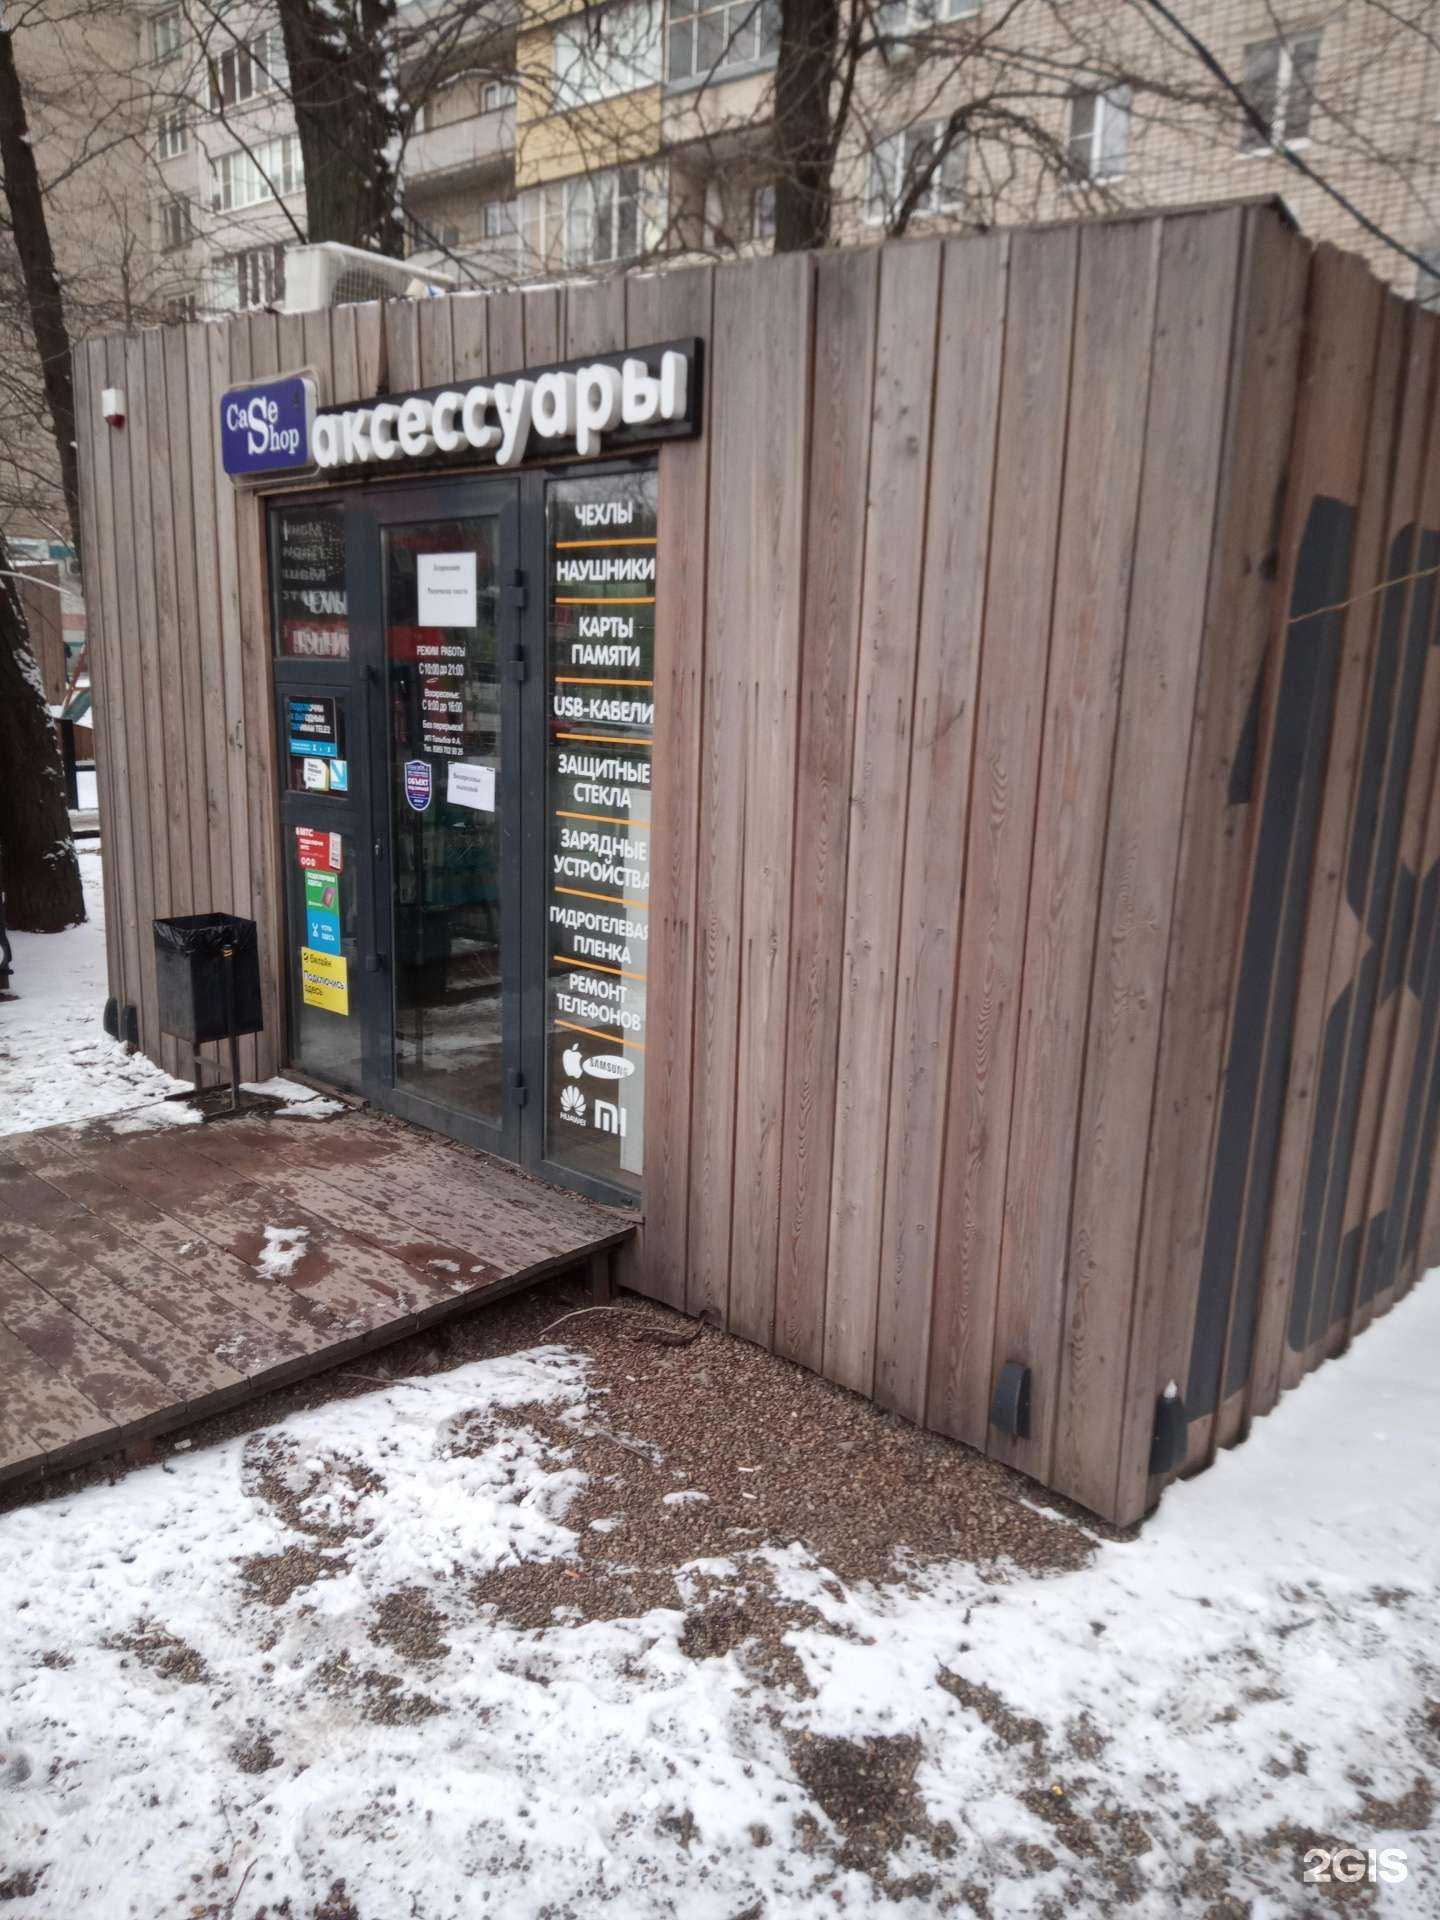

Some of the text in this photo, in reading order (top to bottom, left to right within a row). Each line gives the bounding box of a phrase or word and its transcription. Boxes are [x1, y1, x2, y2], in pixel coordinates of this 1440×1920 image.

[313, 350, 688, 467] аксессуары
[575, 502, 633, 526] ЧЕХЛЫ
[556, 558, 656, 581] НАУШНИКИ
[579, 616, 634, 639] КАРТЫ
[440, 646, 465, 657] РАБОТЫ
[571, 644, 641, 667] ПАМЯТИ
[448, 664, 464, 677] 21:00
[553, 696, 654, 723] USB-КАБЕЛИ
[558, 754, 650, 784] ЗАЩИТНЫЕ
[573, 783, 632, 808] СТЕКЛА
[560, 828, 647, 861] ЗАРЯДНЫЕ
[553, 854, 650, 890] УСТРОЙСТВА
[573, 935, 632, 964] ПЛЕНКА
[569, 973, 628, 1003] РЕМОНТ
[556, 993, 642, 1031] ТЕЛЕФОНОВ
